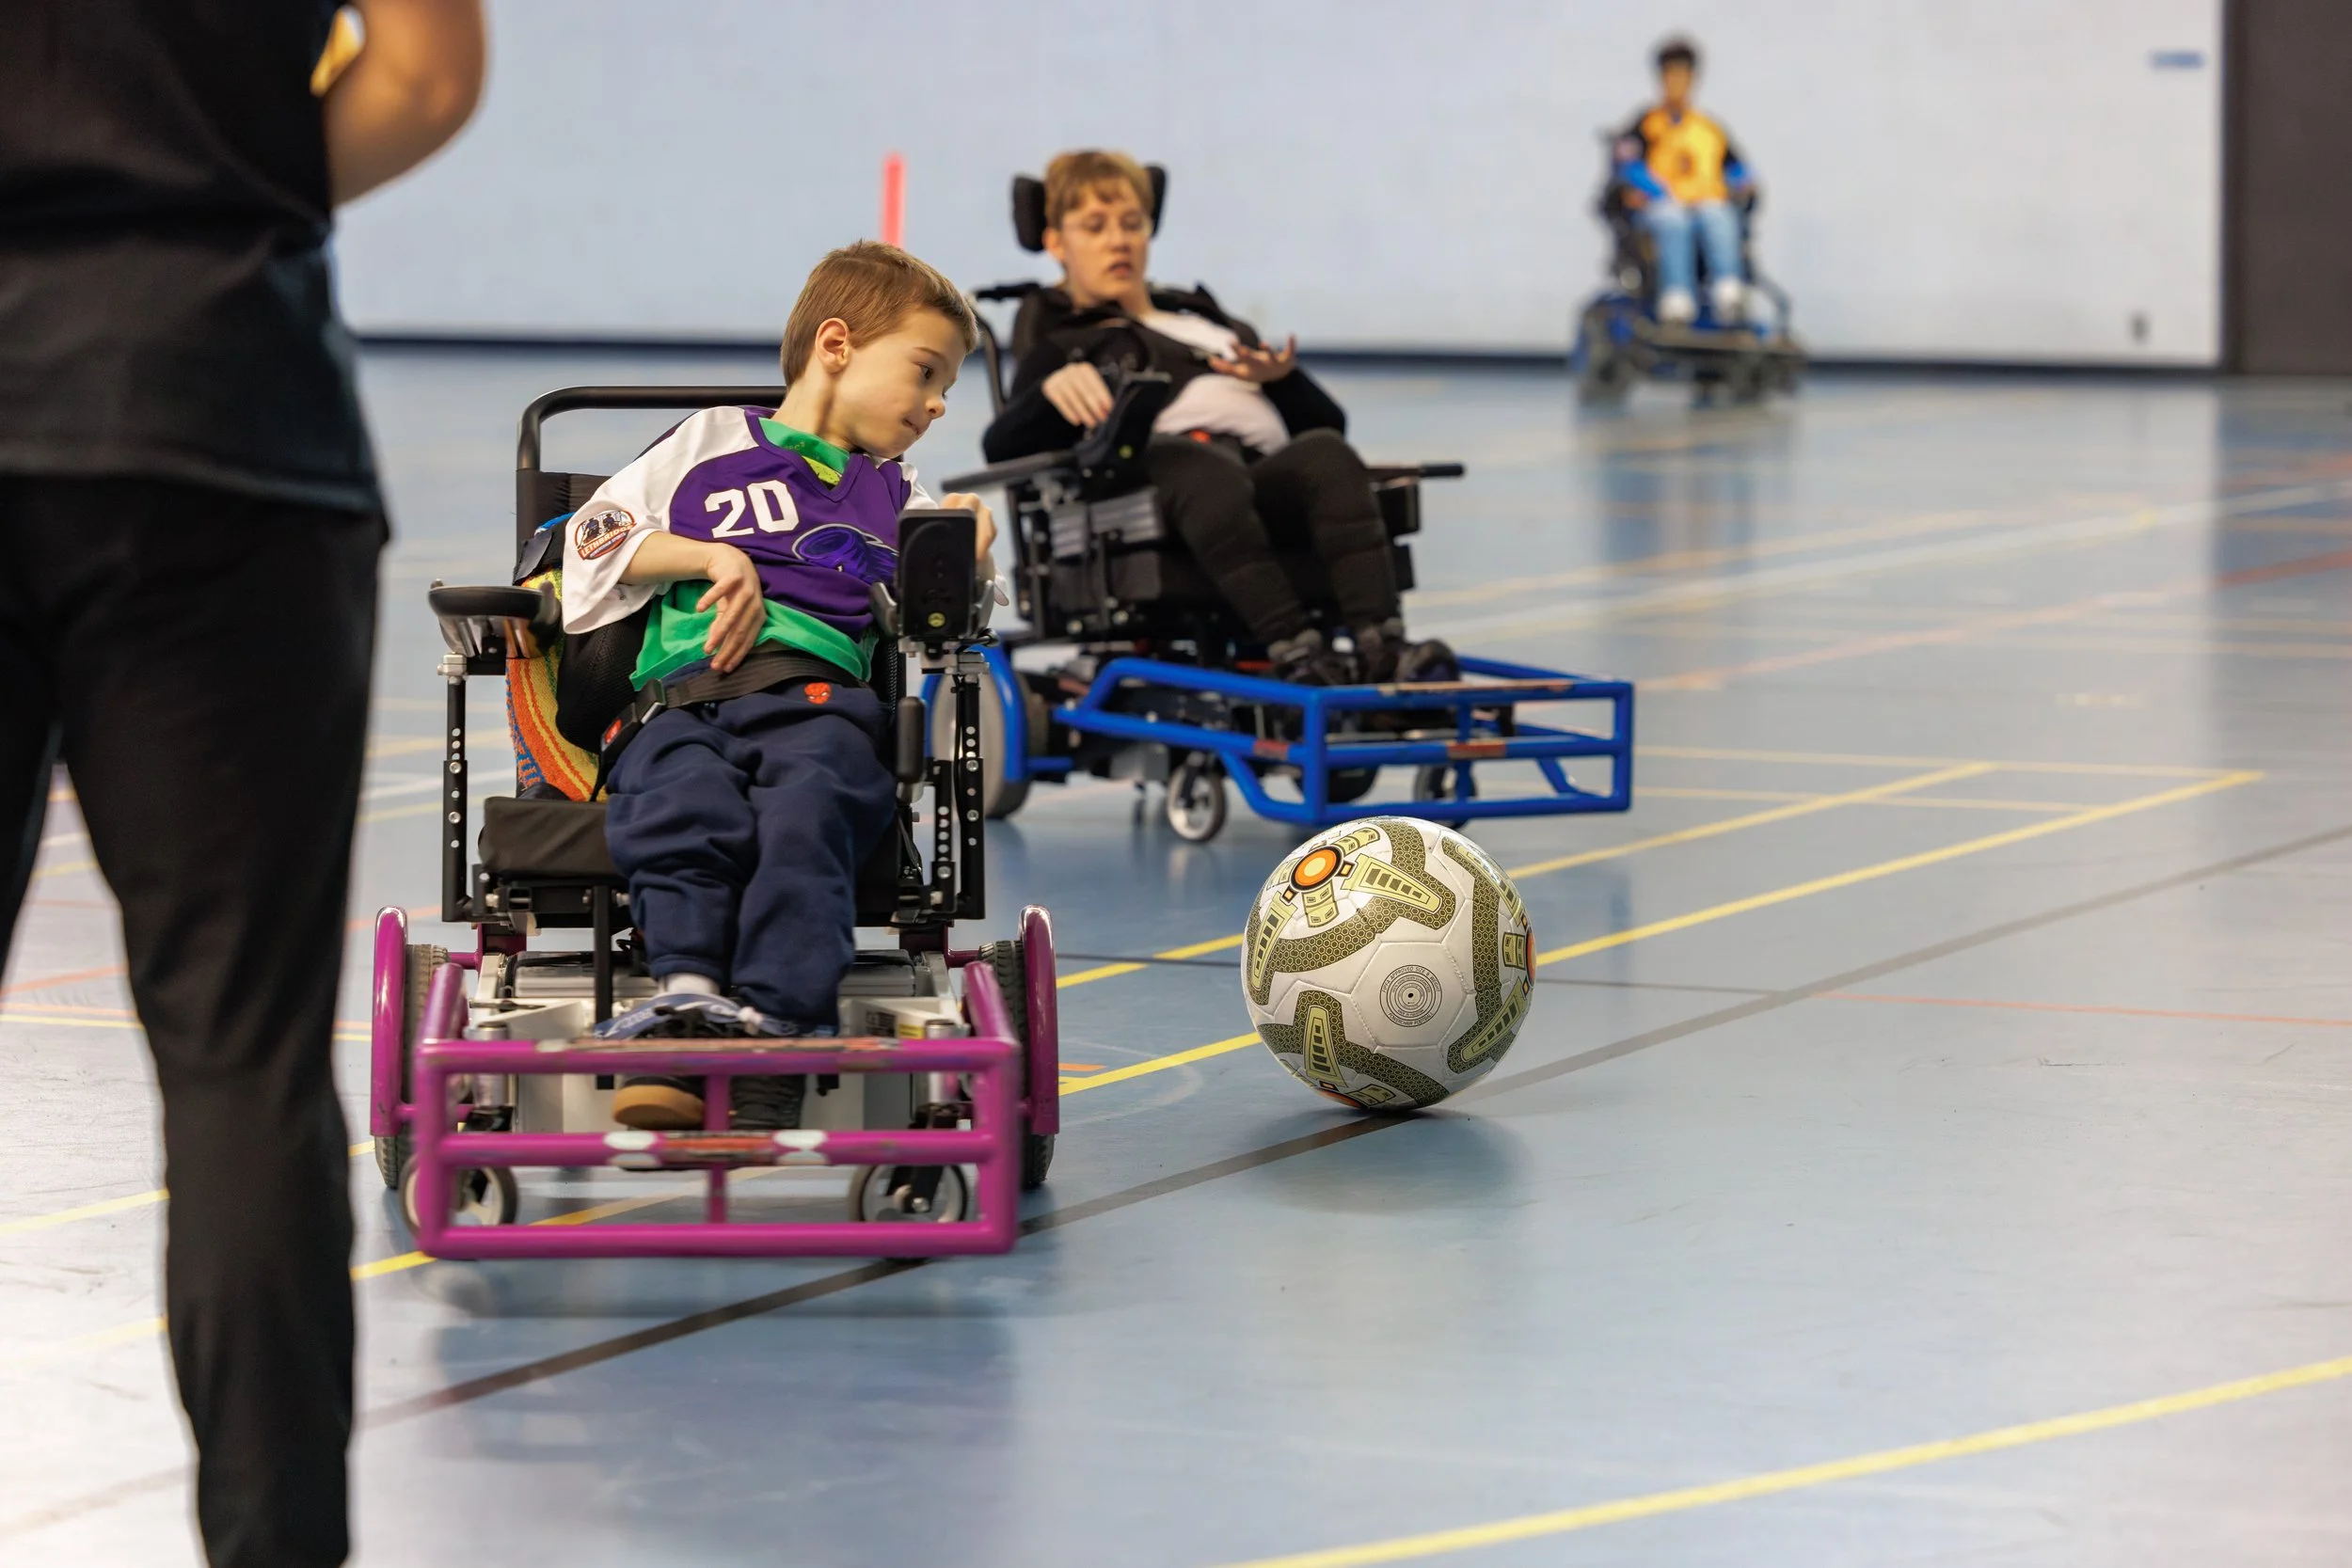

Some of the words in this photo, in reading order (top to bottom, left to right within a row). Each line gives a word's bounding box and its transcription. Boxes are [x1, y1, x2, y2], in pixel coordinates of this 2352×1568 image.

[705, 480, 799, 538] 20
[1391, 966, 1413, 980] APPROVED
[1415, 966, 1426, 974] SIZE
[1388, 1012, 1413, 1025] POWERCHAIR
[1413, 1012, 1434, 1025] FOOTBALL
